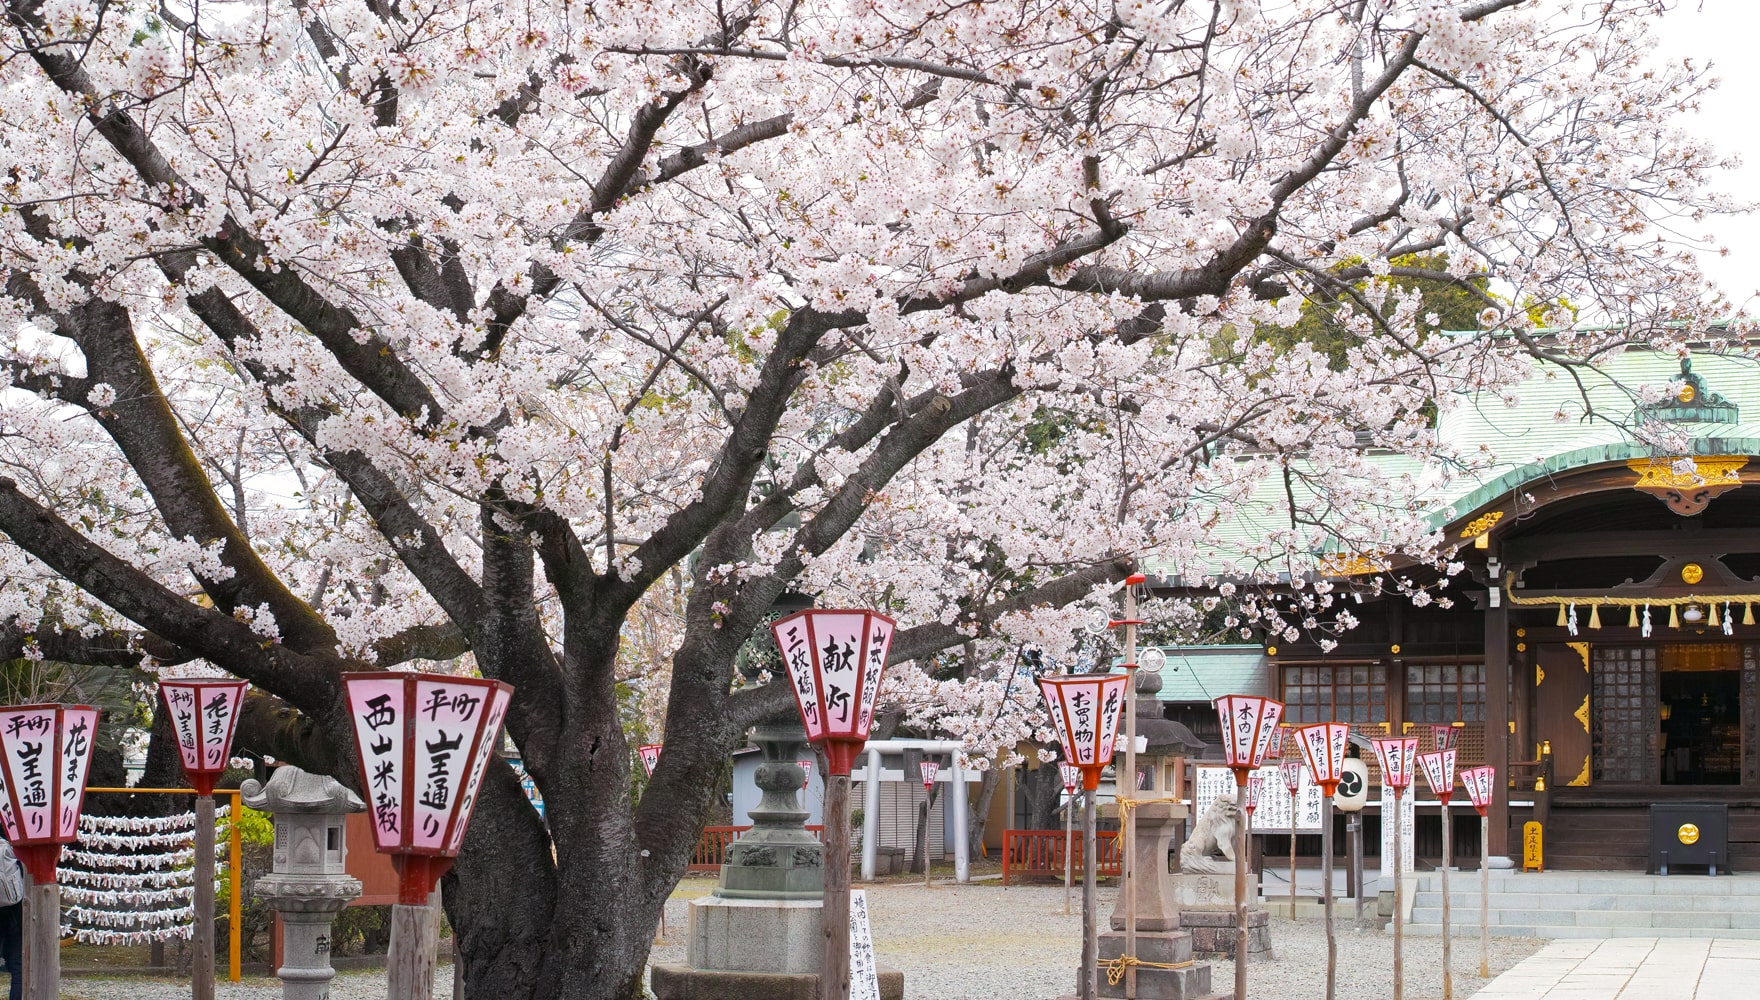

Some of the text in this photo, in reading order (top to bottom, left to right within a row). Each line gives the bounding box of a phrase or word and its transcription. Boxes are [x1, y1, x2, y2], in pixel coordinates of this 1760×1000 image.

[170, 689, 194, 709] 平町
[422, 688, 480, 723] 平町
[787, 626, 818, 725] 三枚橋町
[822, 634, 857, 723] 献灯
[5, 714, 52, 740] 平町
[178, 710, 196, 764] 山王通り
[203, 692, 229, 765] 花まつり
[1072, 690, 1094, 762] お買物は
[1103, 688, 1118, 757] 花まつり
[1237, 702, 1254, 761] 木内ビル
[1309, 729, 1327, 779] 陽だまり
[16, 740, 48, 833] 山王通り
[62, 716, 88, 833] 花まつり
[362, 693, 400, 835] 西山米穀
[419, 729, 464, 839] 山王通り
